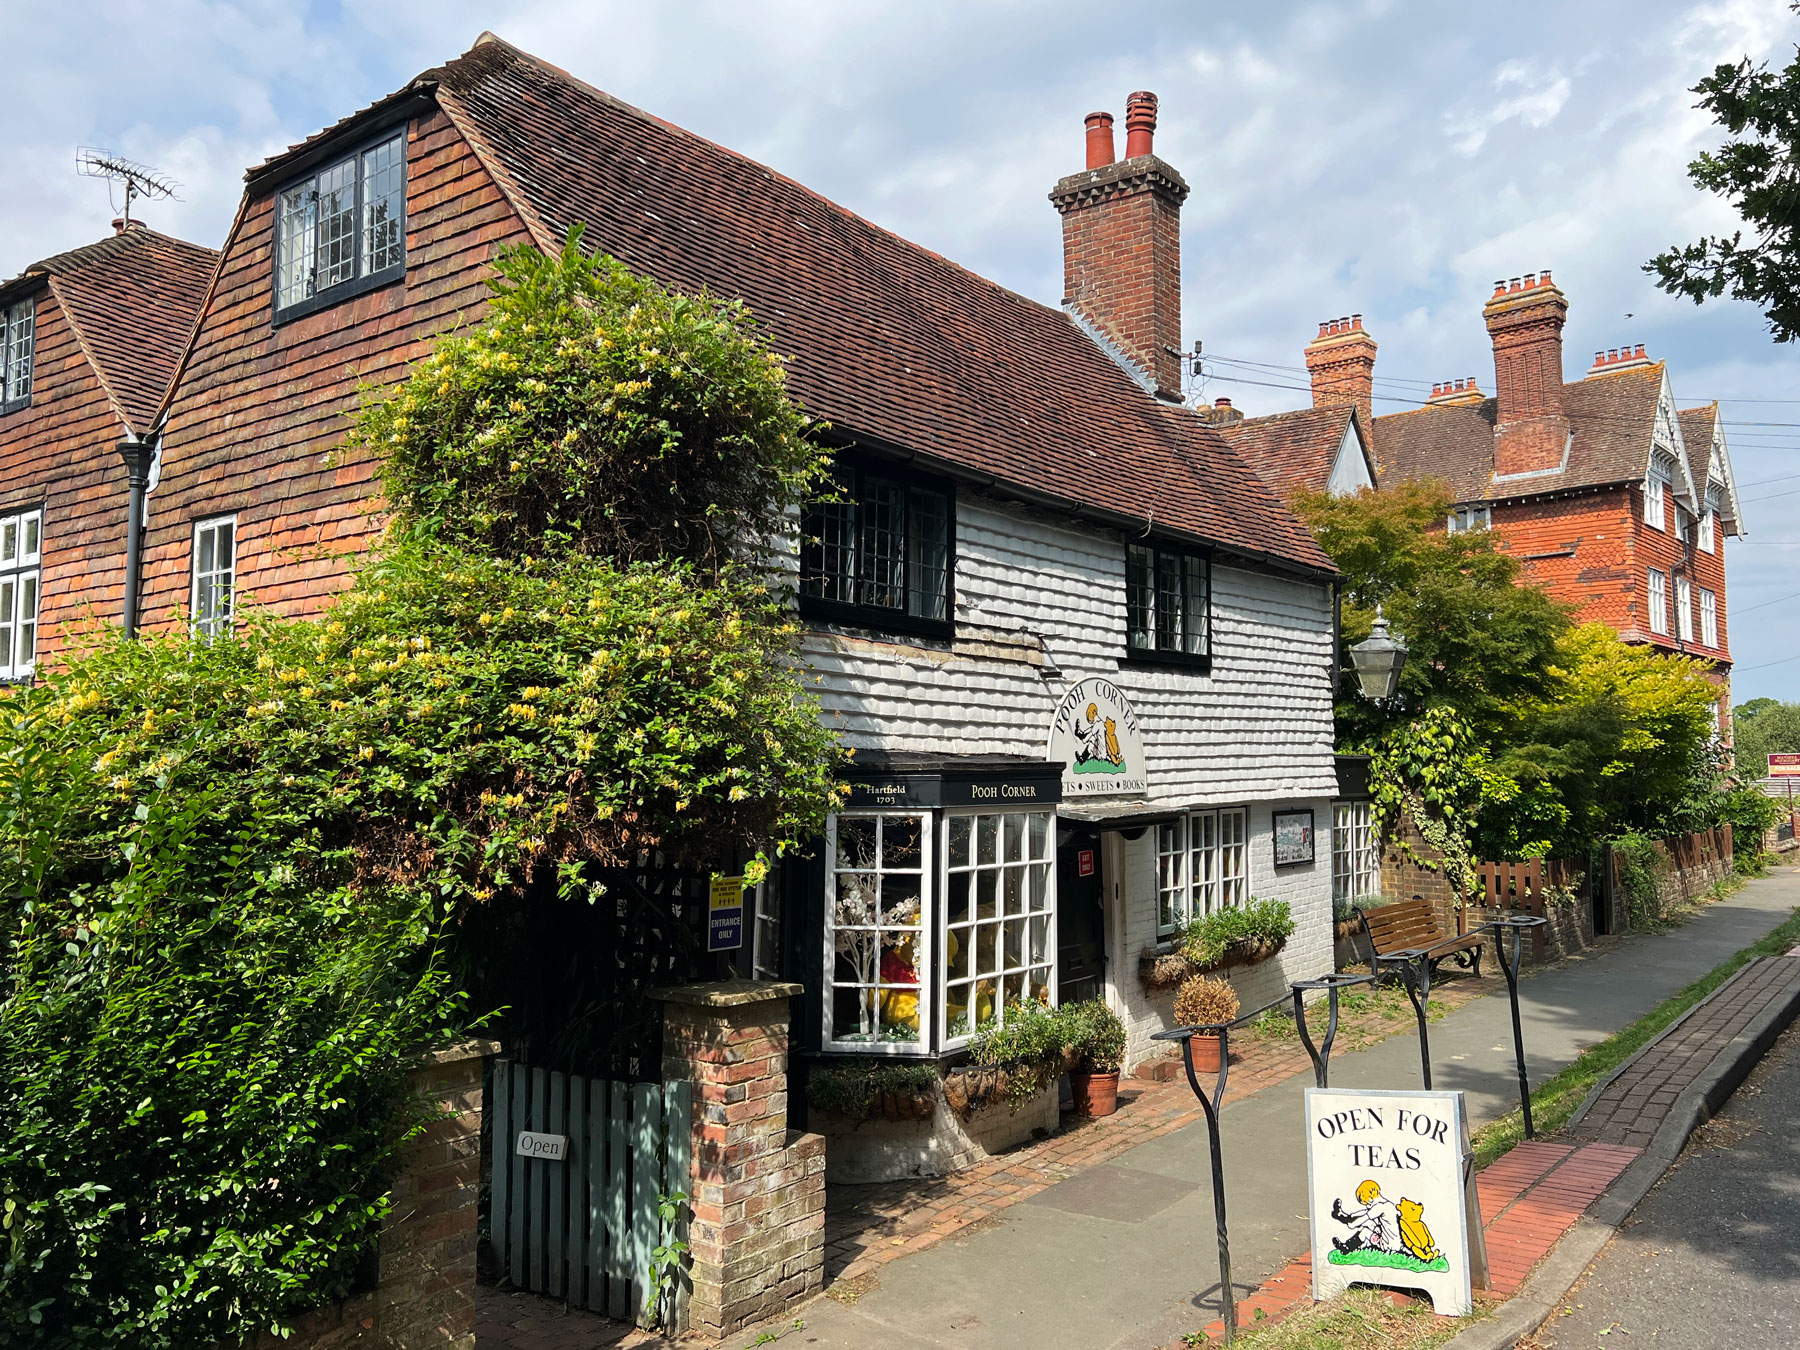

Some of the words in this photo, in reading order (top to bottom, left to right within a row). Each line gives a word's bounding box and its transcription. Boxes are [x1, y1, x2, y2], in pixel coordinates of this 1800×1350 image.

[1055, 685, 1086, 735] POOH
[1095, 681, 1137, 736] CORNER
[866, 784, 906, 794] Hartfield
[1085, 780, 1114, 792] SWEETS
[1122, 779, 1145, 790] BOOKS
[876, 796, 896, 805] 1703
[711, 916, 741, 928] ENTRANCE
[718, 929, 733, 940] ONLY
[1317, 1107, 1384, 1139] OPEN
[1397, 1109, 1449, 1145] FOR
[521, 1135, 559, 1156] Open
[1347, 1144, 1421, 1170] TEAS
